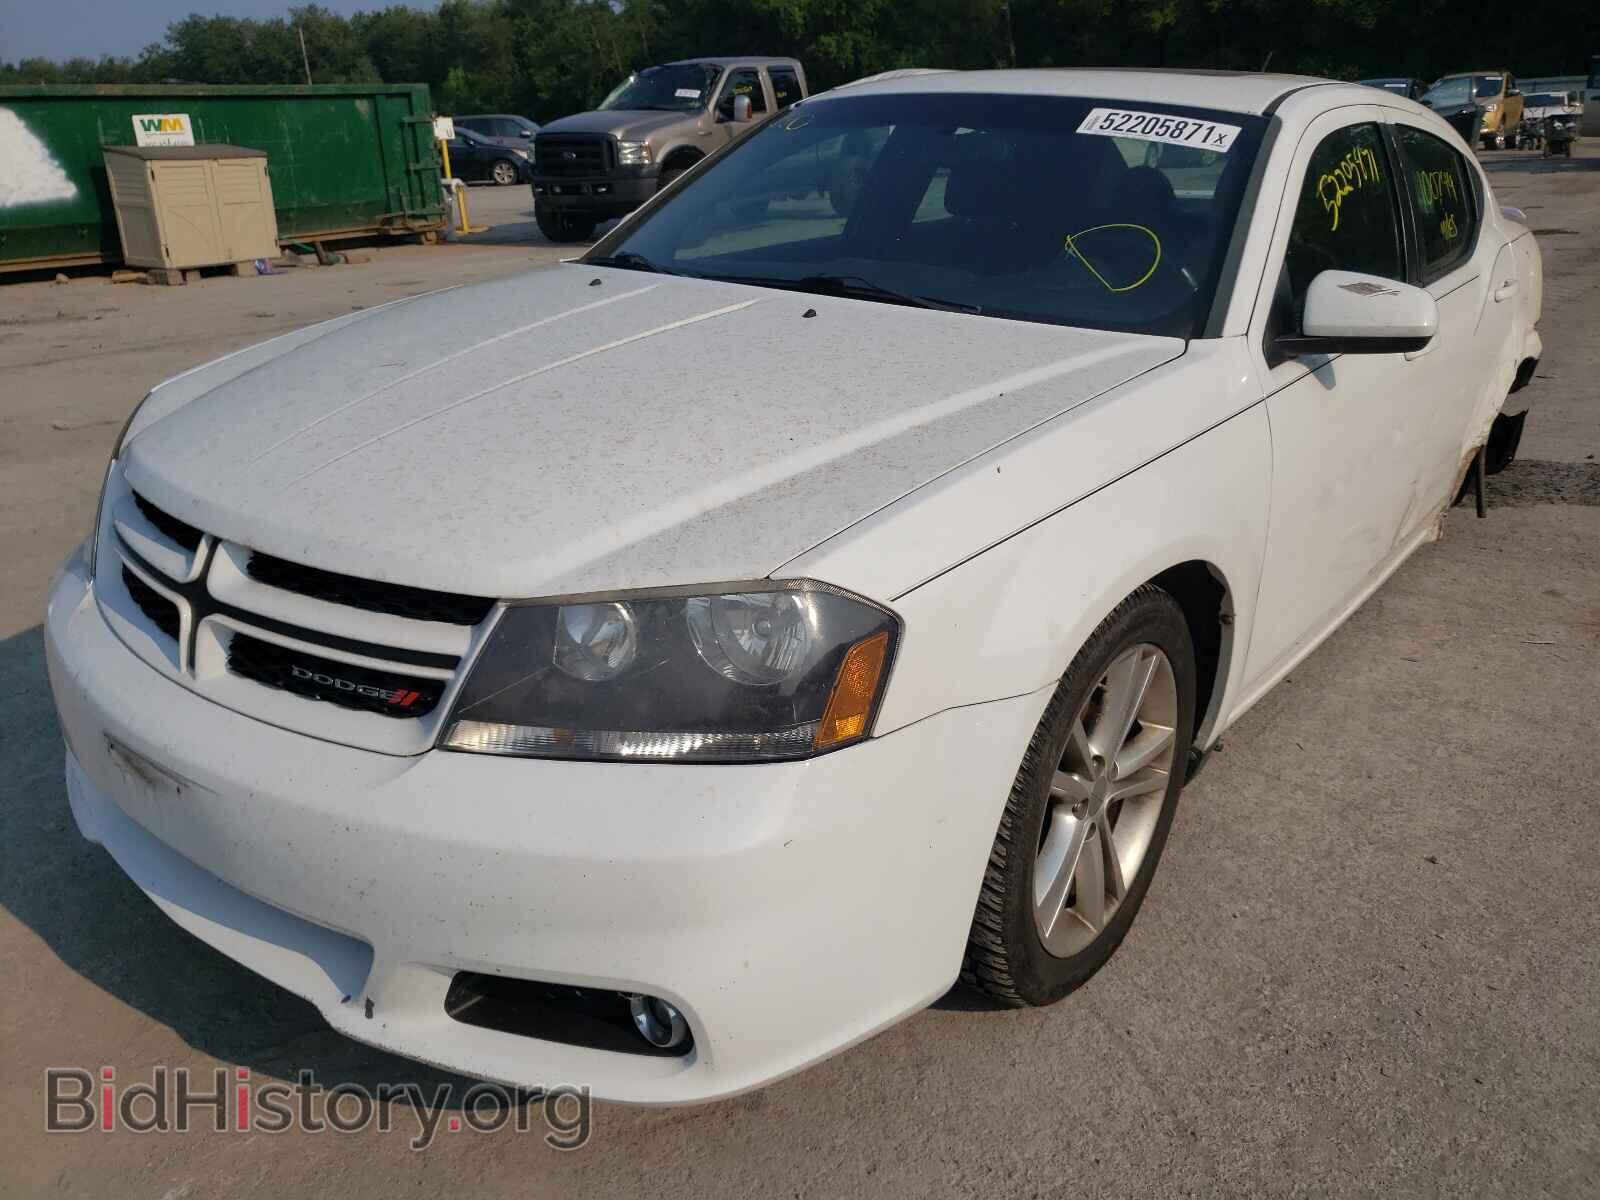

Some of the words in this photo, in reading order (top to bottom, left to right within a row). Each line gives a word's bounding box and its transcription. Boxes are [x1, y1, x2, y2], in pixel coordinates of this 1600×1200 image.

[140, 118, 184, 131] WM
[1100, 112, 1216, 143] 52205871
[291, 664, 402, 699] DODGE
